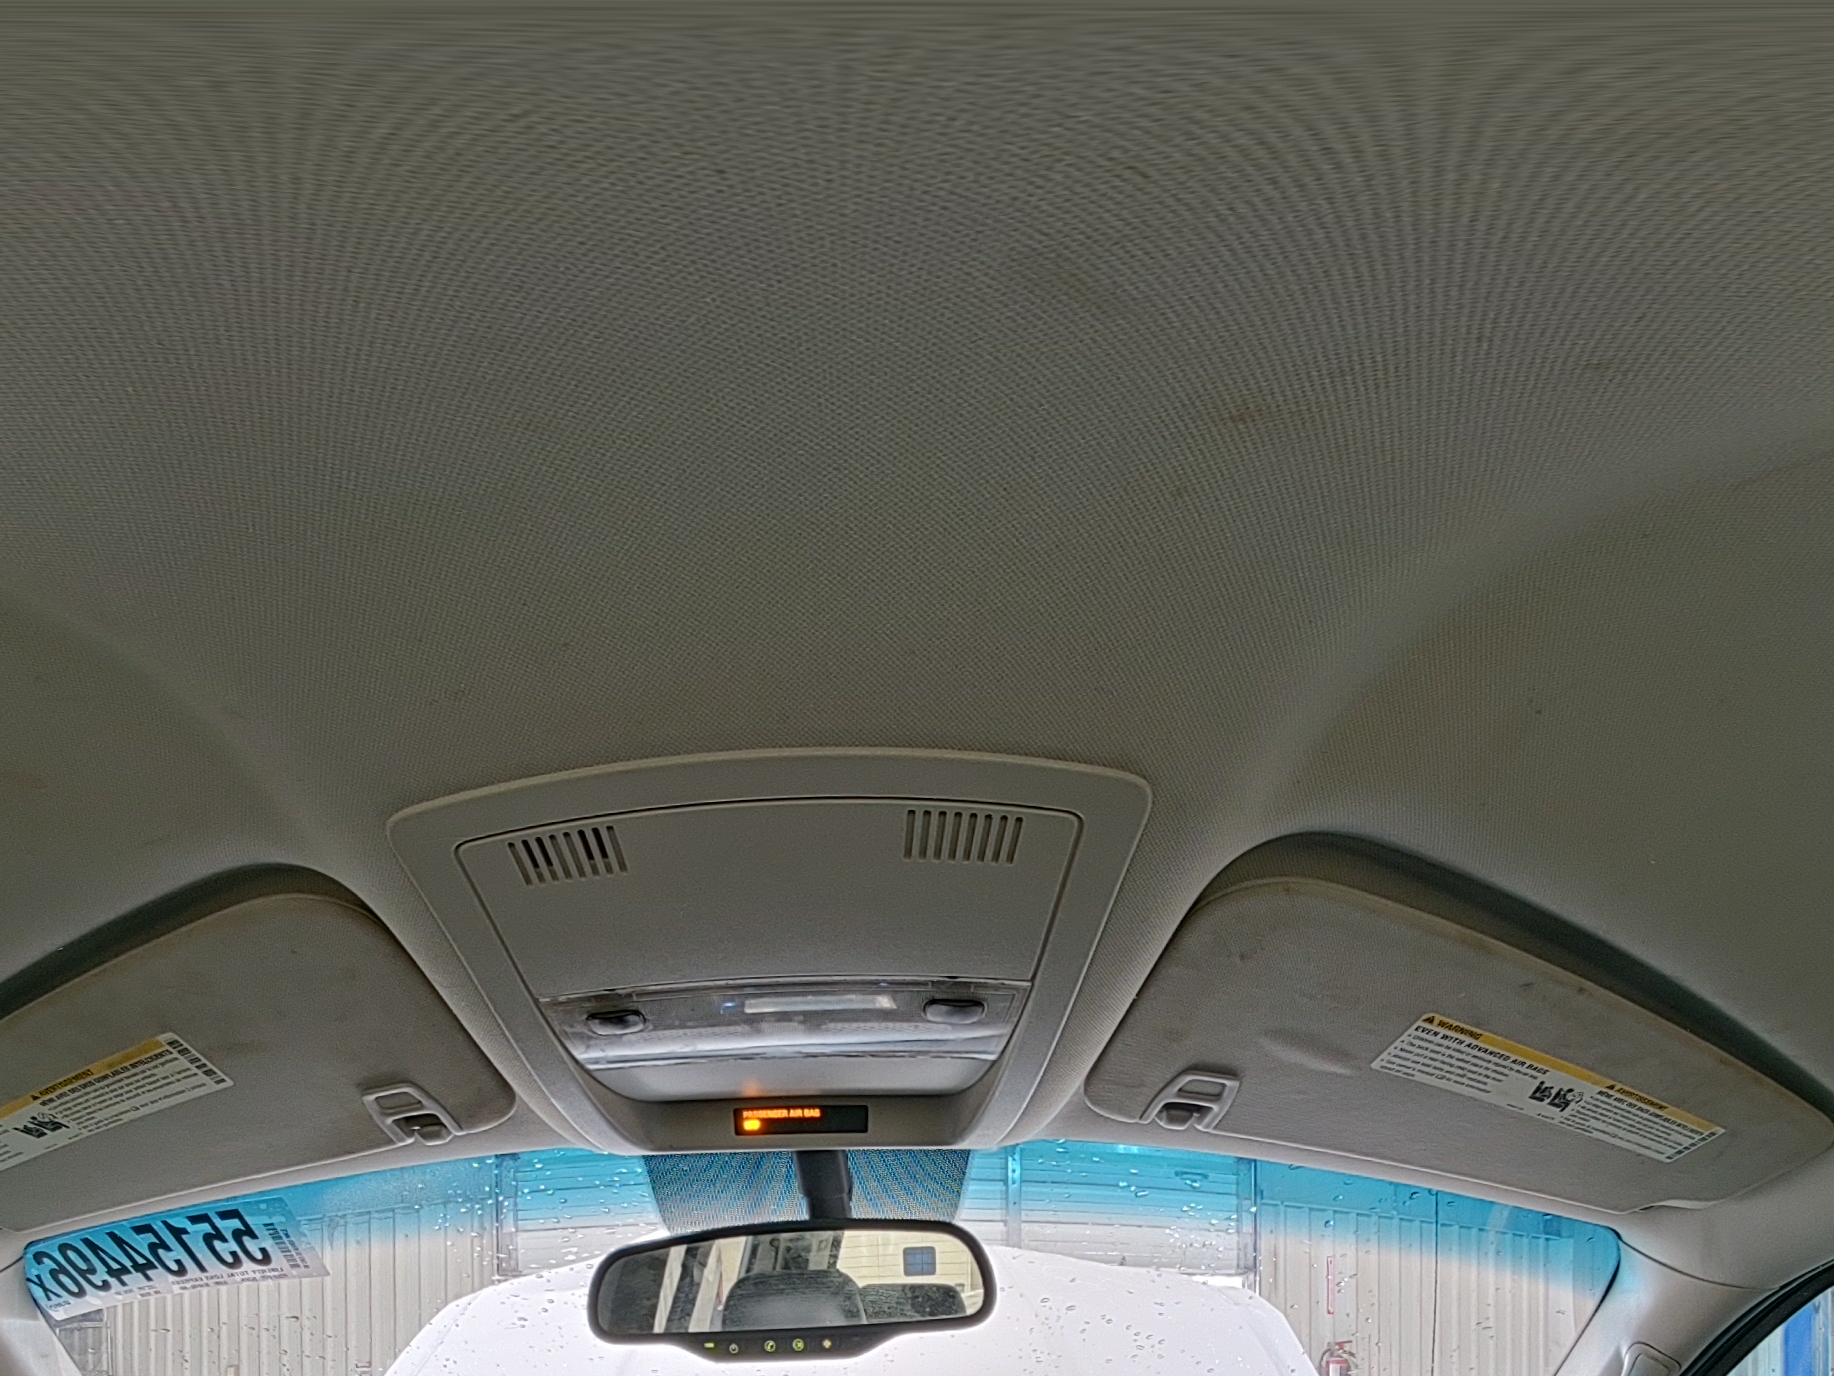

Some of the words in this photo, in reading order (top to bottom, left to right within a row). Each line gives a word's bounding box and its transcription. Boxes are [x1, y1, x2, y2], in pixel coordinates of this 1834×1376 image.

[1437, 1019, 1483, 1040] WARNING
[1414, 1025, 1440, 1038] EVEN
[1440, 1032, 1466, 1046] WITH
[1465, 1042, 1511, 1062] ADVANCED
[1510, 1057, 1527, 1068] AIR
[1526, 1063, 1551, 1076] BAGS
[742, 1109, 788, 1119] PASSENGER
[789, 1108, 803, 1118] AIR
